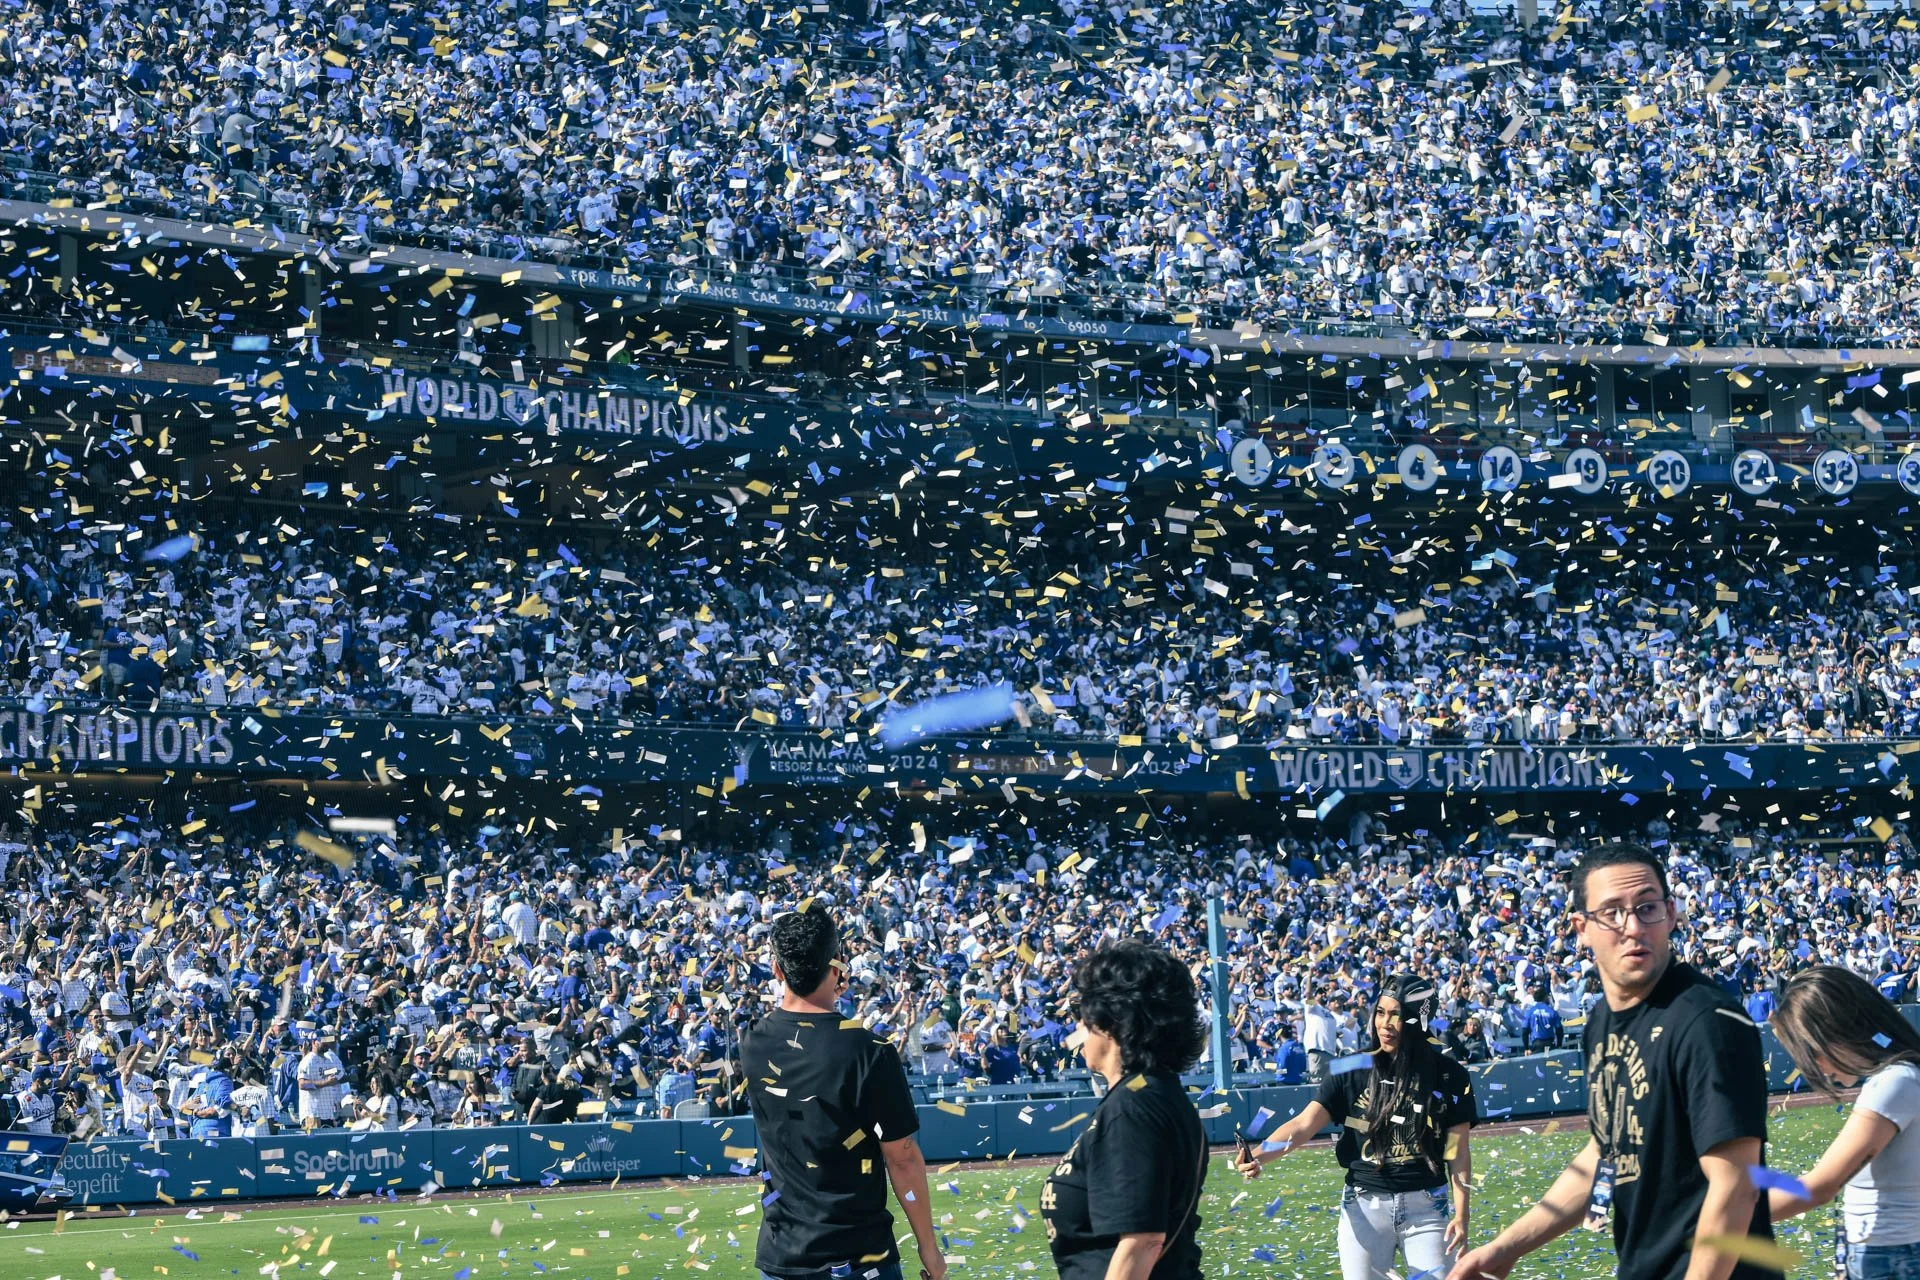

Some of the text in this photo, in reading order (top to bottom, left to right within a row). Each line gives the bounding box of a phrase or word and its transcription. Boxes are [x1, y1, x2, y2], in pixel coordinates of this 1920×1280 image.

[571, 269, 600, 284] FOR
[610, 274, 638, 288] FAN
[665, 280, 738, 298] ASISANCE
[922, 308, 949, 322] TEXT
[1068, 321, 1107, 334] 69050
[382, 373, 498, 421] WORLD
[542, 390, 729, 442] CHAMPIONS
[1408, 451, 1426, 480] 4
[1487, 456, 1515, 482] 14
[1574, 457, 1600, 484] 19
[1654, 460, 1686, 485] 20
[1738, 459, 1771, 486] 24
[1823, 460, 1854, 486] 32
[1709, 702, 1721, 714] 50
[769, 761, 813, 773] RESORT
[826, 762, 868, 775] CSINO
[889, 754, 938, 769] 2024
[1136, 760, 1184, 775] 2025
[1273, 750, 1383, 788] WORLD
[1427, 750, 1608, 788] CHAMPIONS
[294, 1149, 400, 1173] Spectrum
[66, 1172, 121, 1195] enefit
